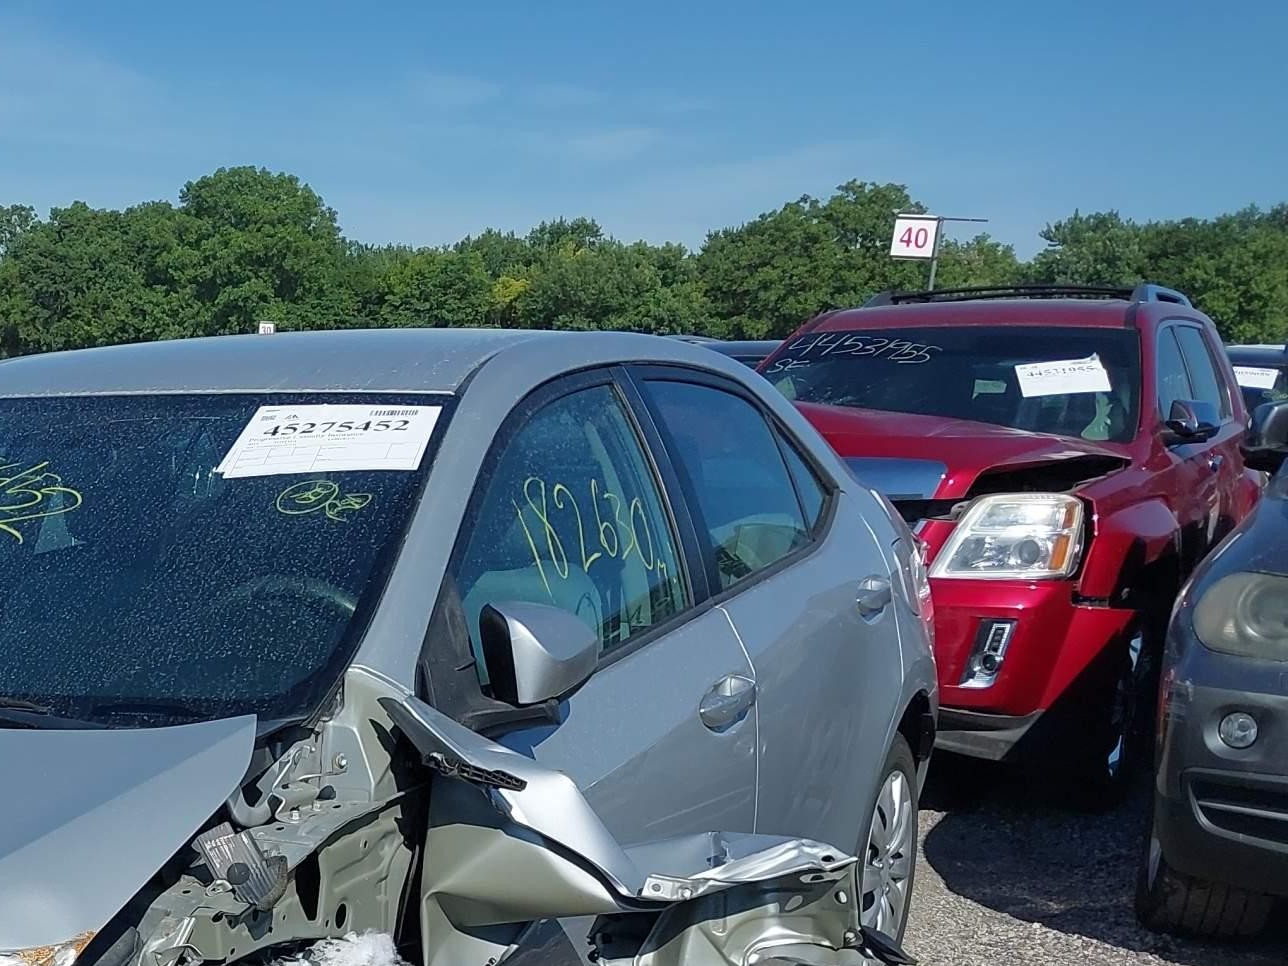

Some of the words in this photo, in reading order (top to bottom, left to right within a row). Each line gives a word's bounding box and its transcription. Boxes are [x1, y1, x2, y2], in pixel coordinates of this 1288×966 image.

[899, 227, 929, 248] 40
[788, 333, 944, 364] 44531955
[263, 419, 411, 437] 45275452
[511, 476, 653, 600] 182630
